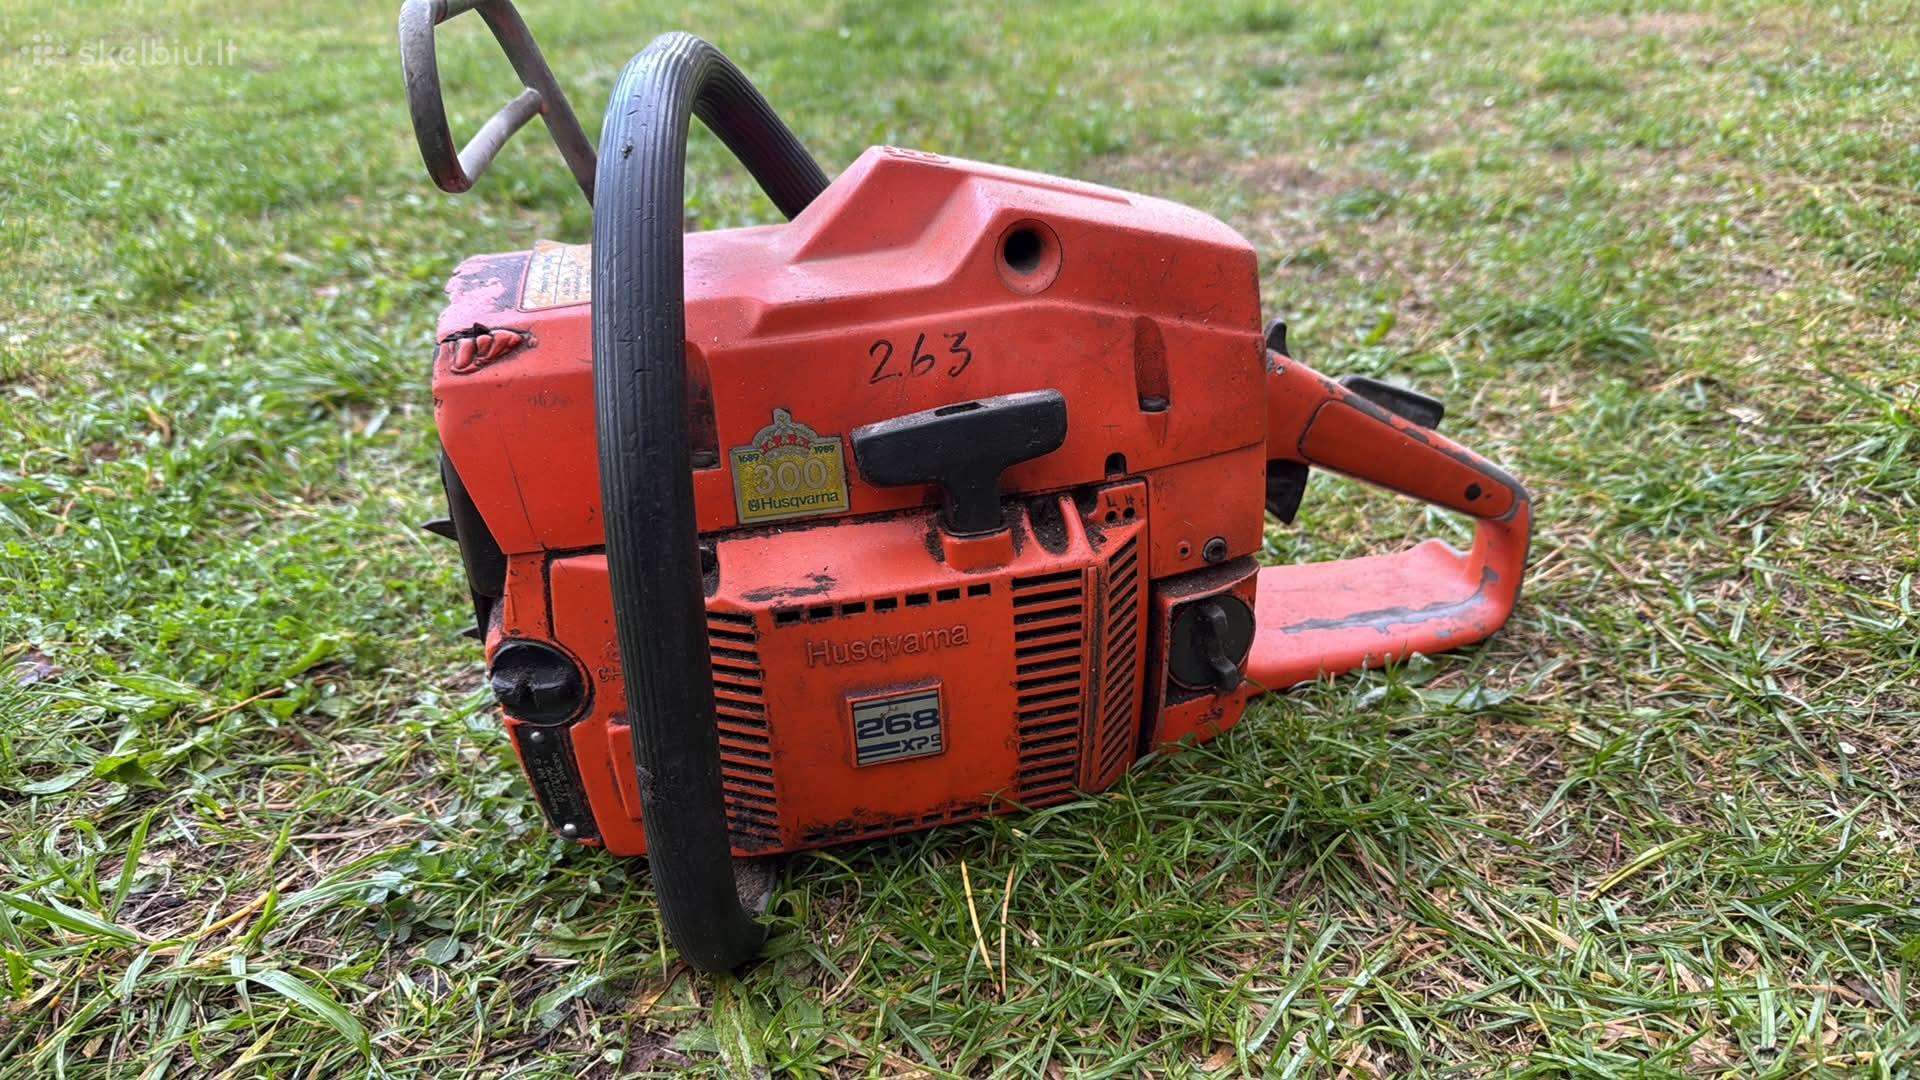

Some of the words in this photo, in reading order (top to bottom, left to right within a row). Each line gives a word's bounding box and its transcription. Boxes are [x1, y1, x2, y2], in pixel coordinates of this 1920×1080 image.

[753, 461, 828, 495] 300
[760, 491, 839, 511] Husqvarna
[806, 624, 969, 667] Husqvarna
[857, 707, 940, 741] 268
